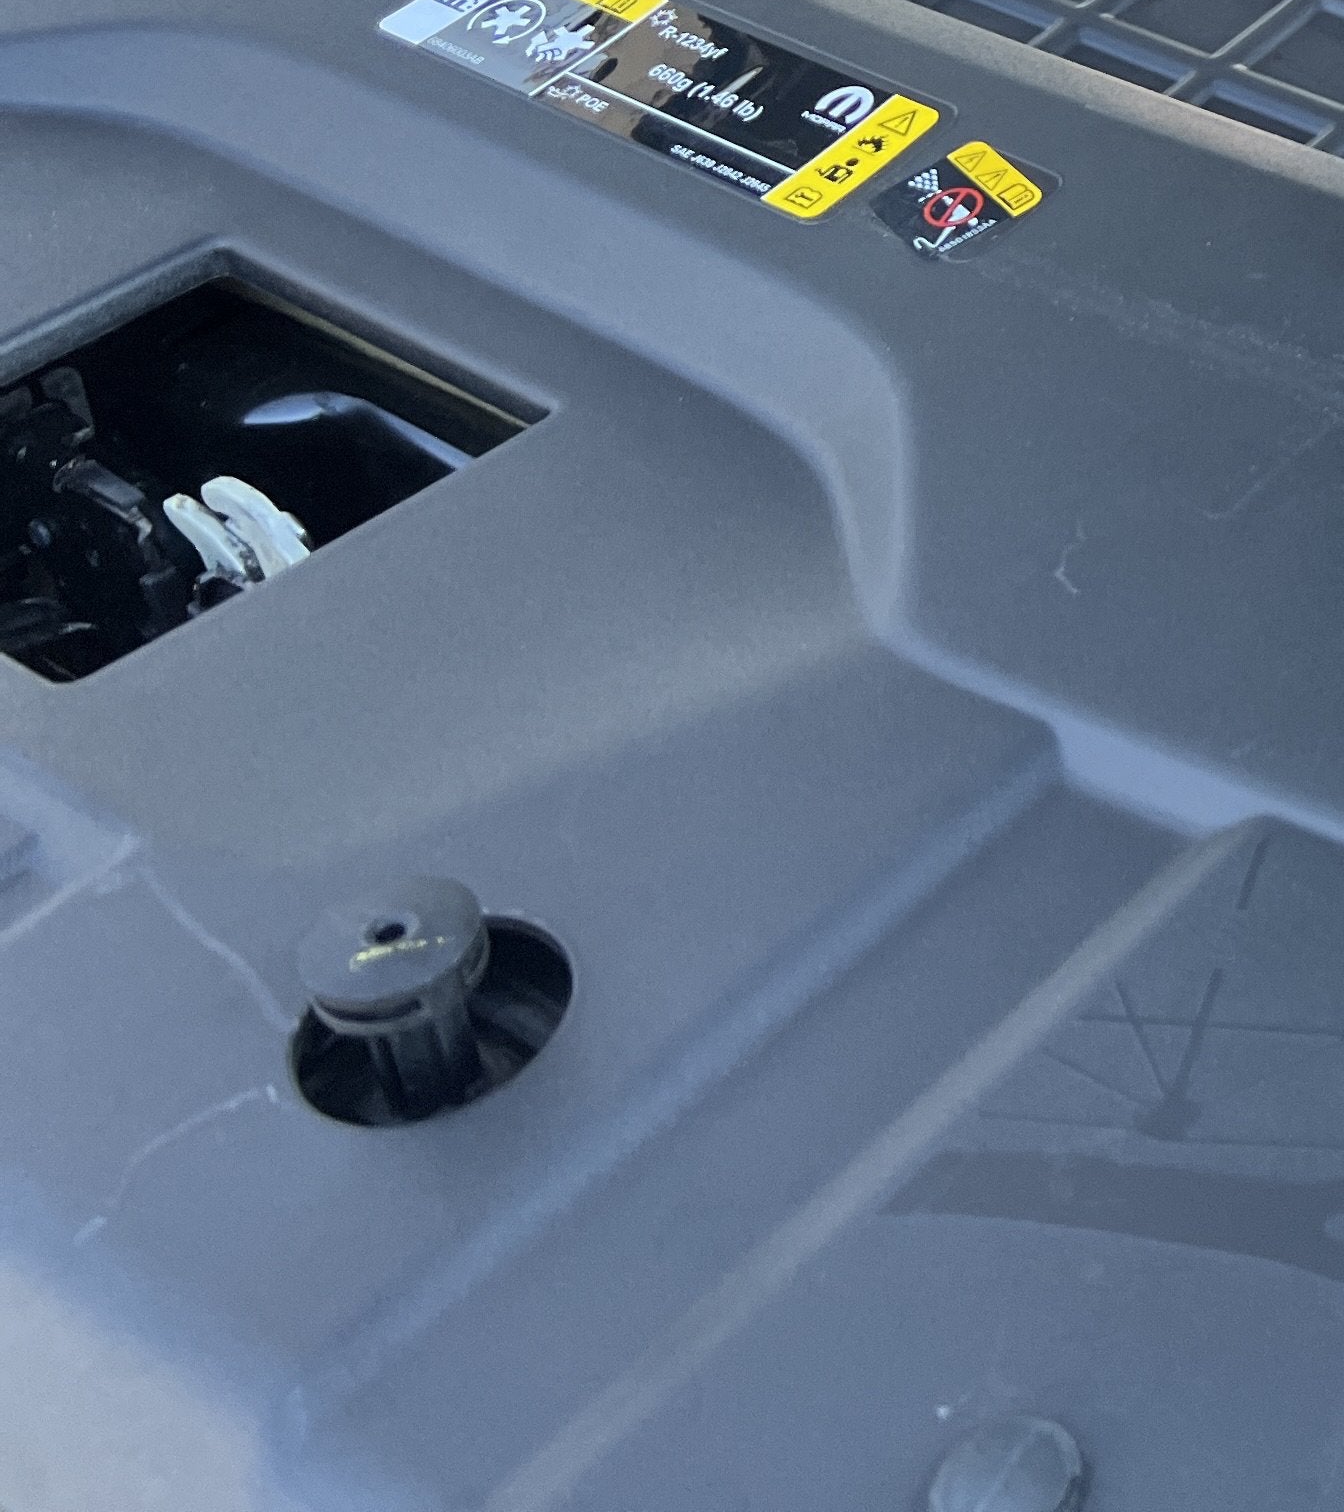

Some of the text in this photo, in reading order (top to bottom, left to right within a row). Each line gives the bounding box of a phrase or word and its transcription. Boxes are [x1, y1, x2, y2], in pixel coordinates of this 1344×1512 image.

[660, 26, 729, 59] R-1234yf
[575, 92, 610, 114] POE
[649, 64, 764, 122] 660g (1.46 lb)
[670, 144, 696, 159] SAE
